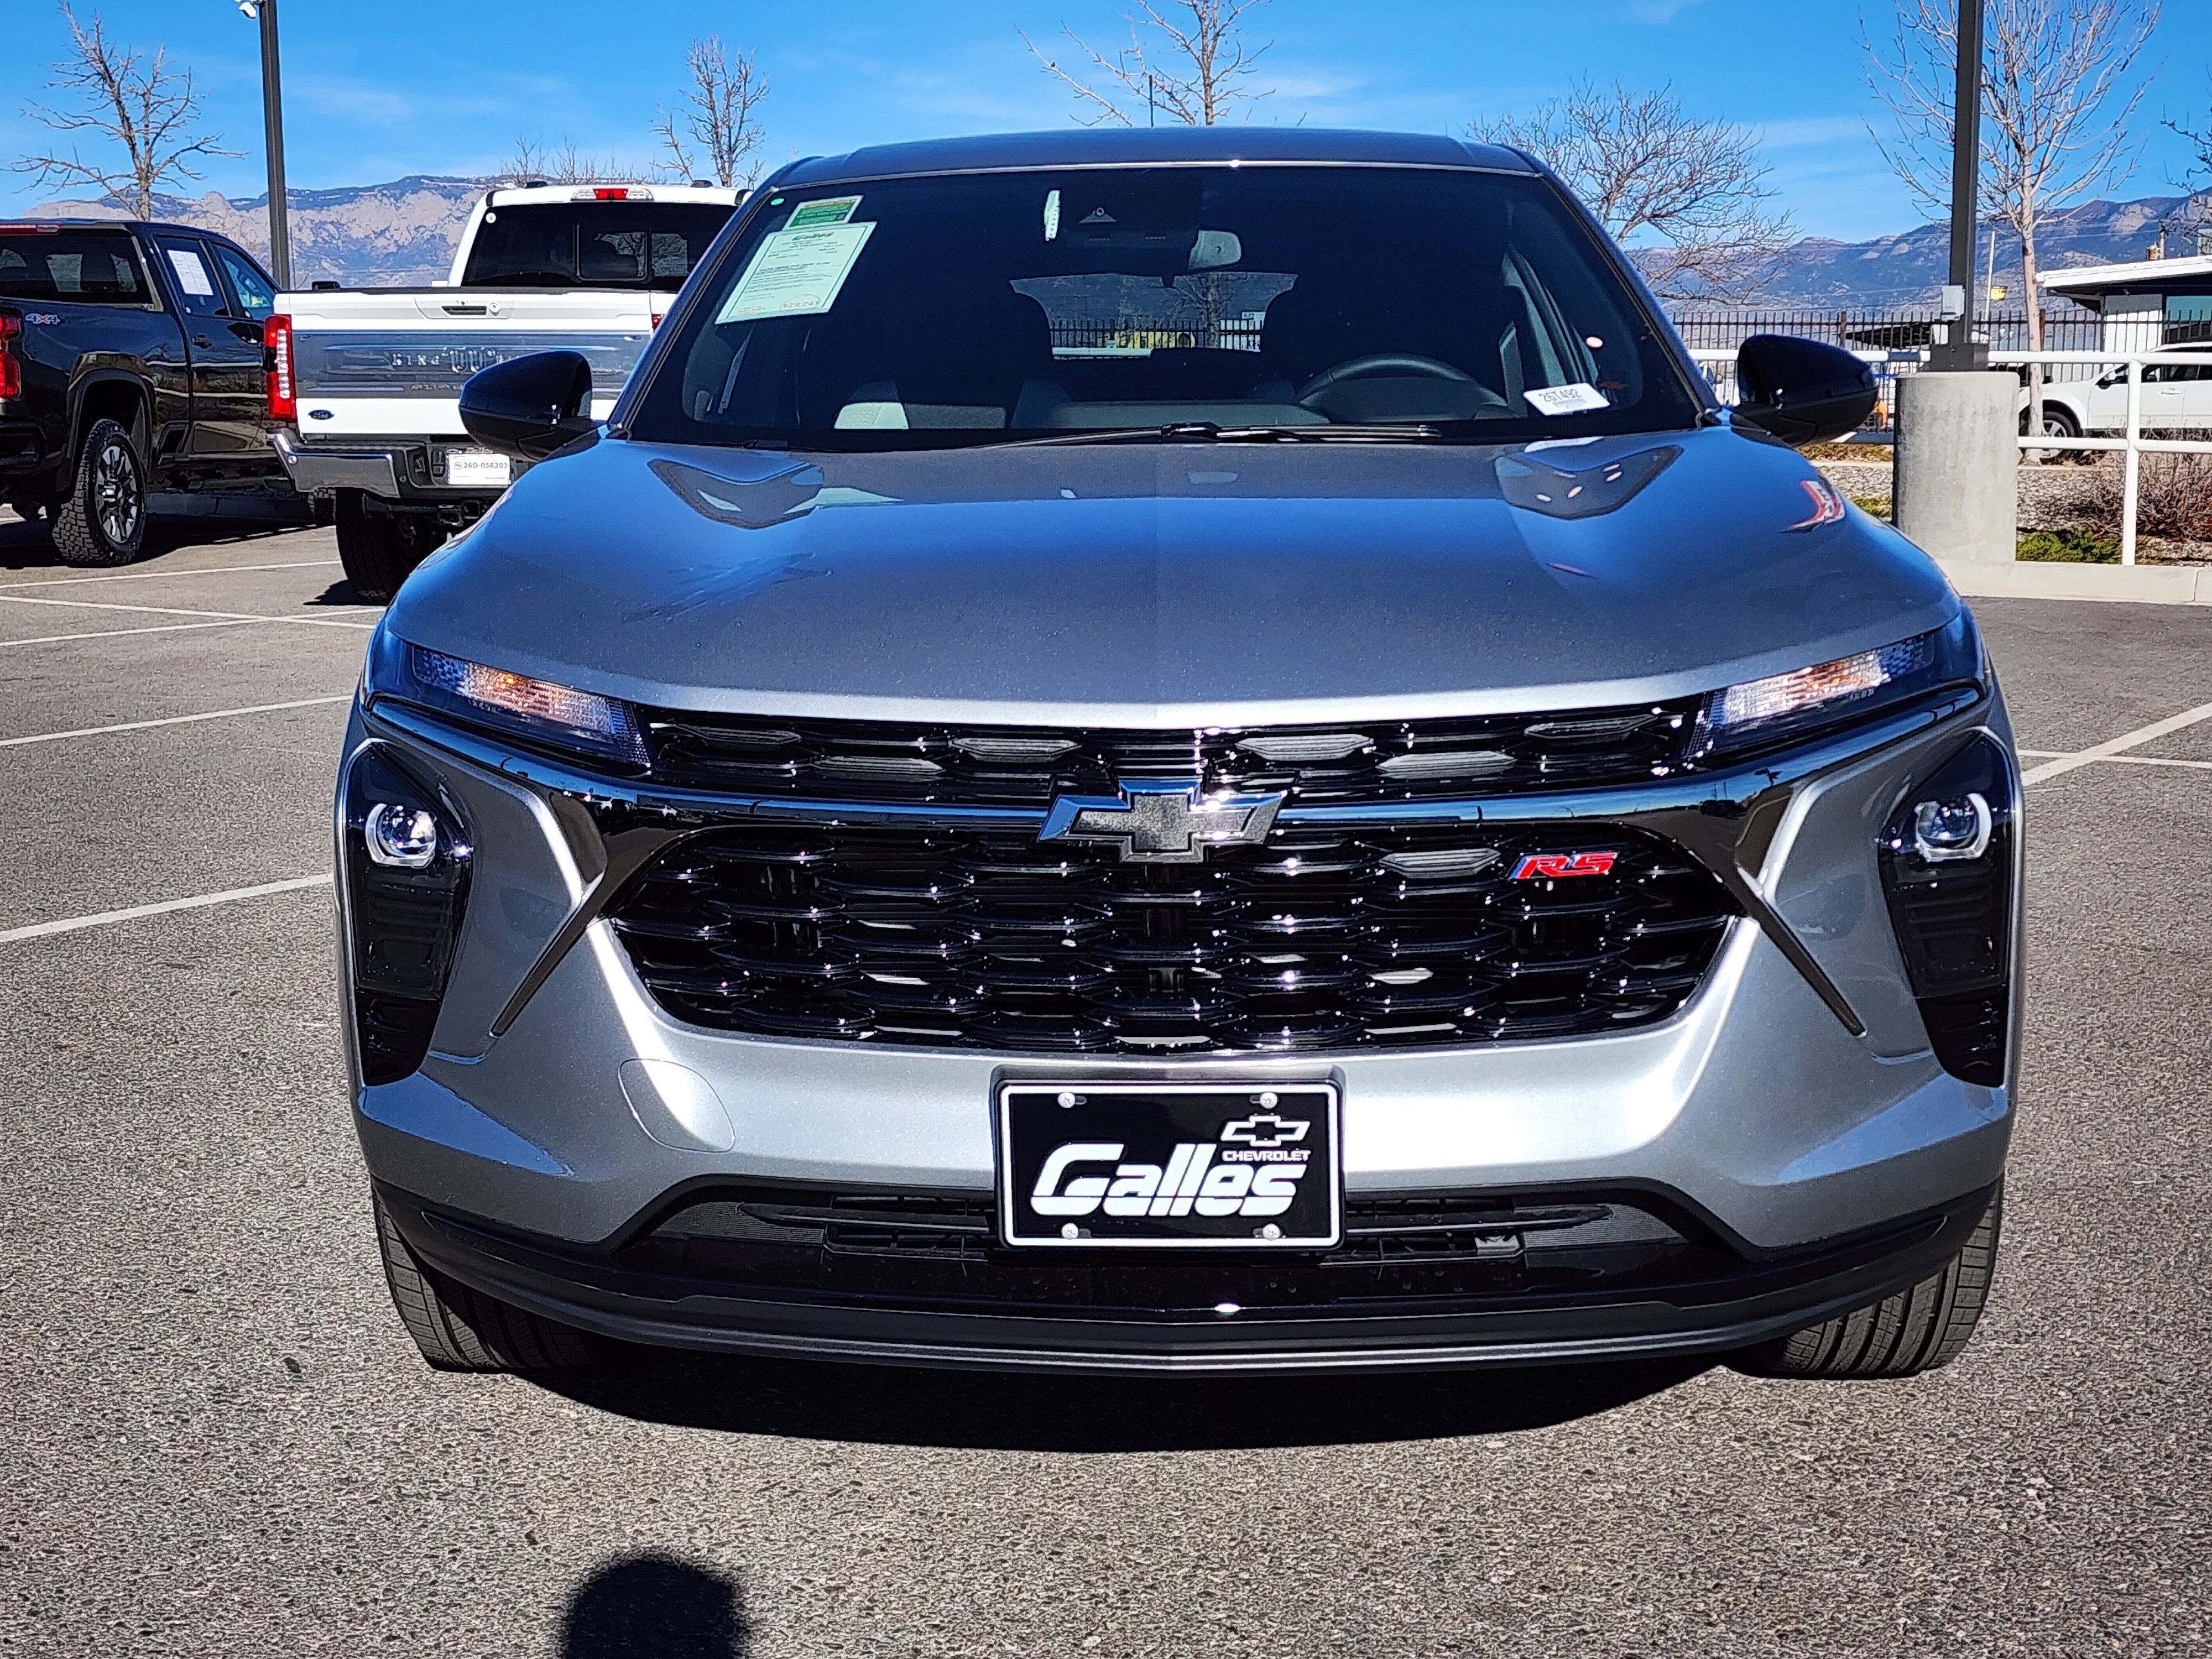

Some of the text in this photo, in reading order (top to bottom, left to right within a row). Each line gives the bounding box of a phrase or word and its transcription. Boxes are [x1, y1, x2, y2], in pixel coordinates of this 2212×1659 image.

[1538, 388, 1583, 402] 26T492
[1511, 852, 1618, 879] RS
[1222, 1150, 1311, 1161] CHEVROLET
[1030, 1143, 1307, 1217] Galles
